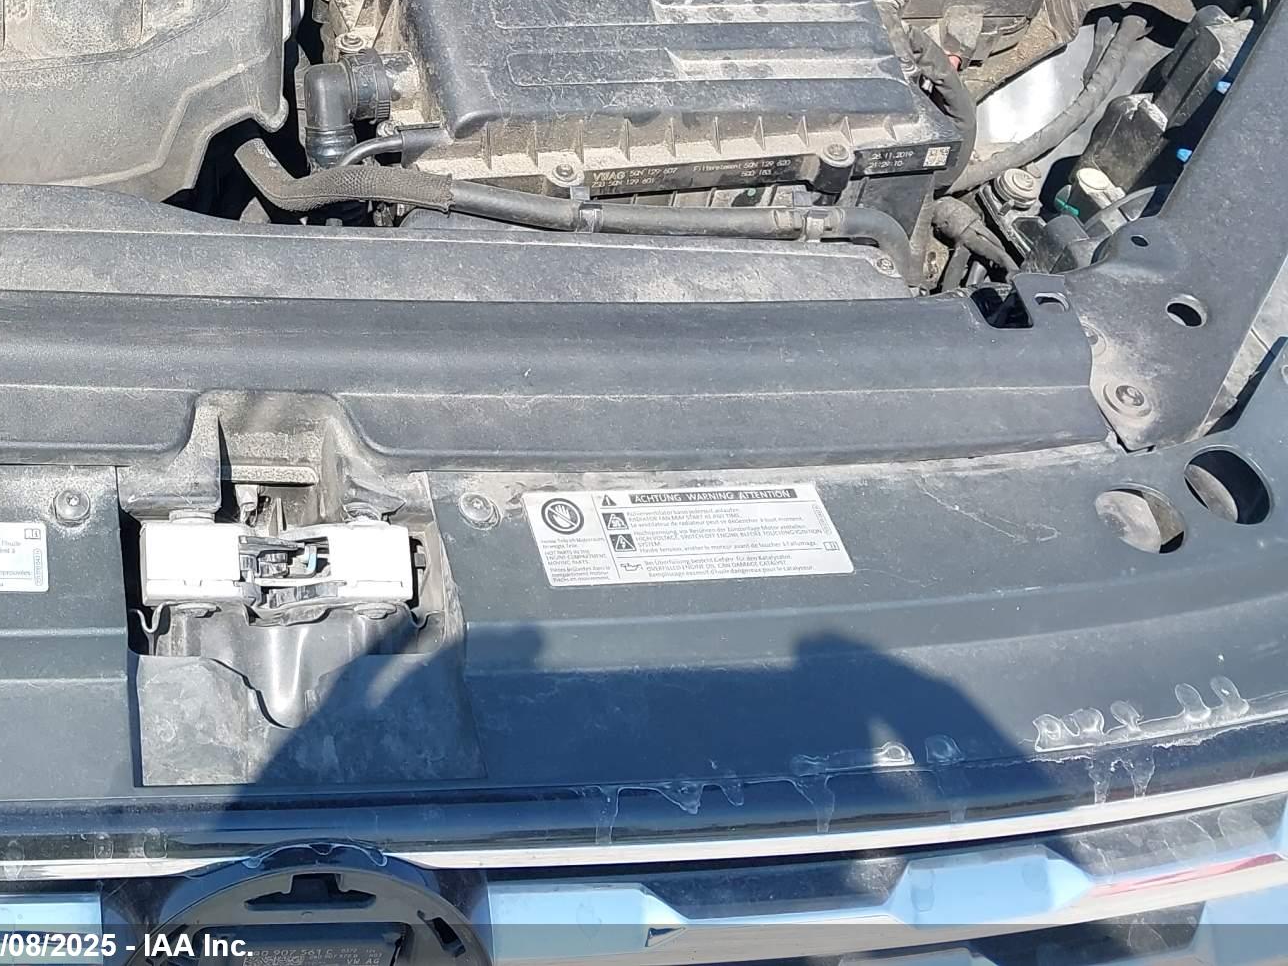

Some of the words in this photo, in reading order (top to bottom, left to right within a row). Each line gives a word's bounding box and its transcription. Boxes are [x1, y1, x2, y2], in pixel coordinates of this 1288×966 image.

[635, 493, 682, 503] ACHTUNG
[686, 491, 734, 501] WARNING
[739, 489, 791, 500] ATTENTION
